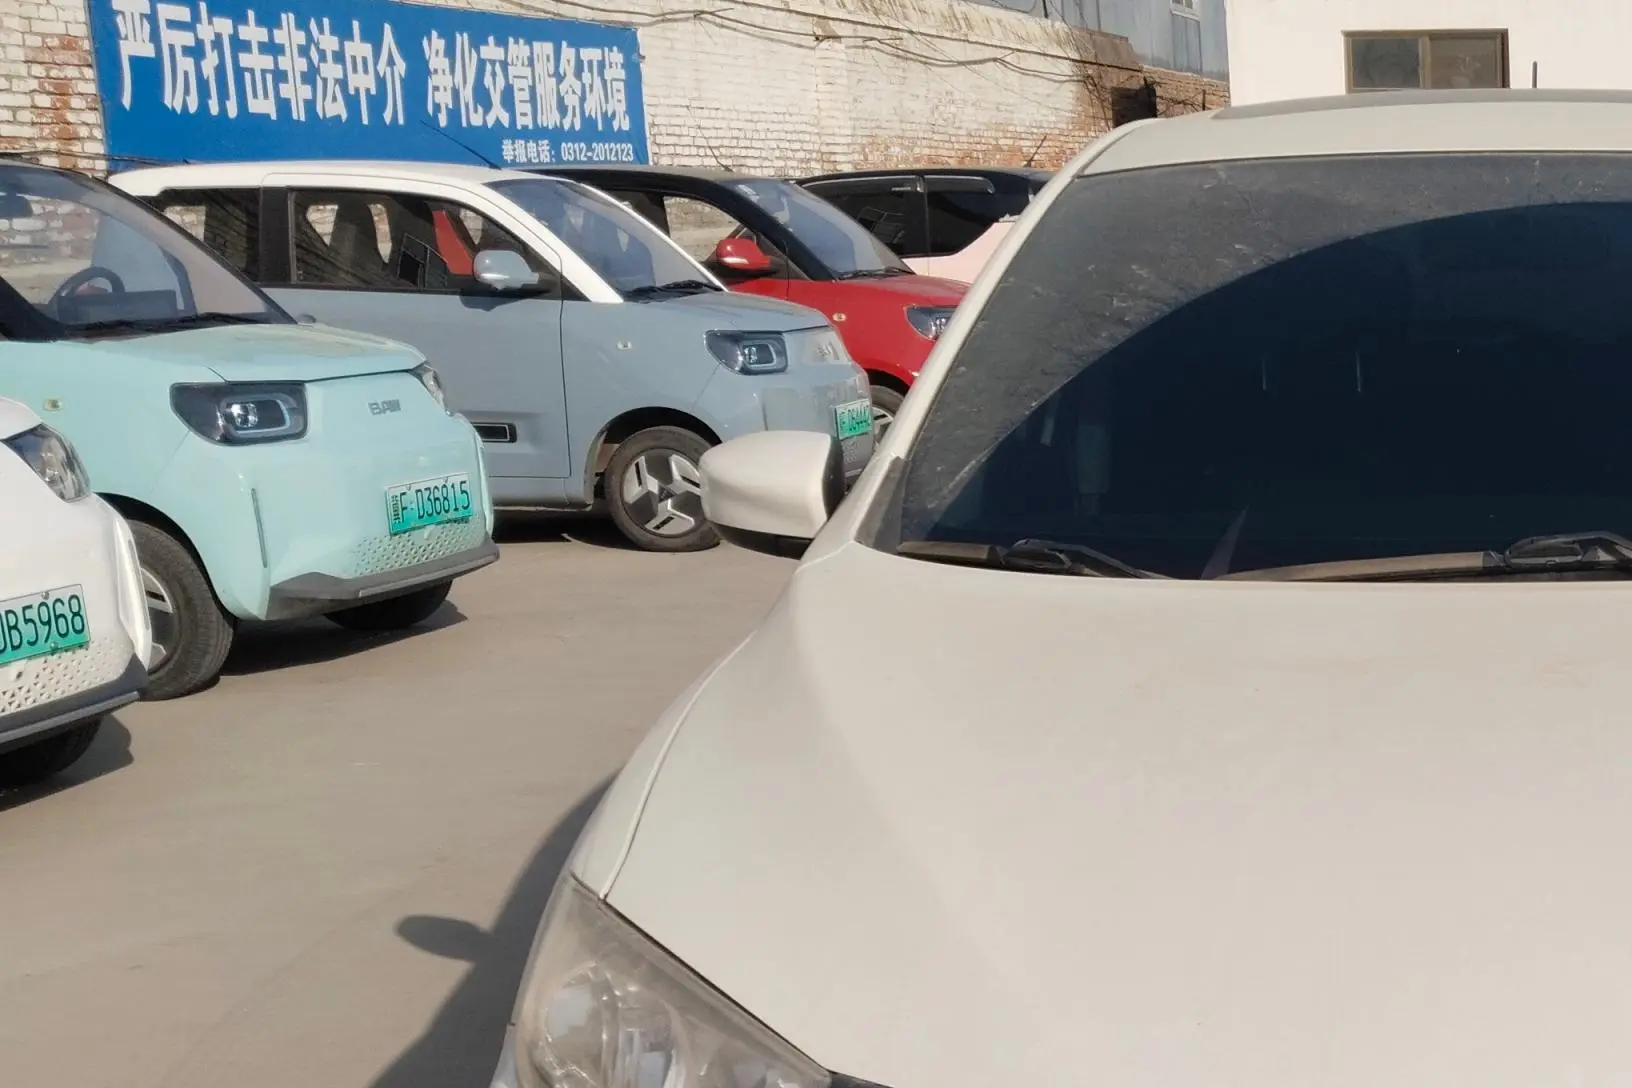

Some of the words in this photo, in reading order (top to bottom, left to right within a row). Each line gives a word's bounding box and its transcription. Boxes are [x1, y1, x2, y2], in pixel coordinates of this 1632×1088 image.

[111, 0, 407, 126] 严厉打击非法中介
[422, 29, 631, 132] 净化交管服务环境
[561, 142, 635, 162] 0312-2012123
